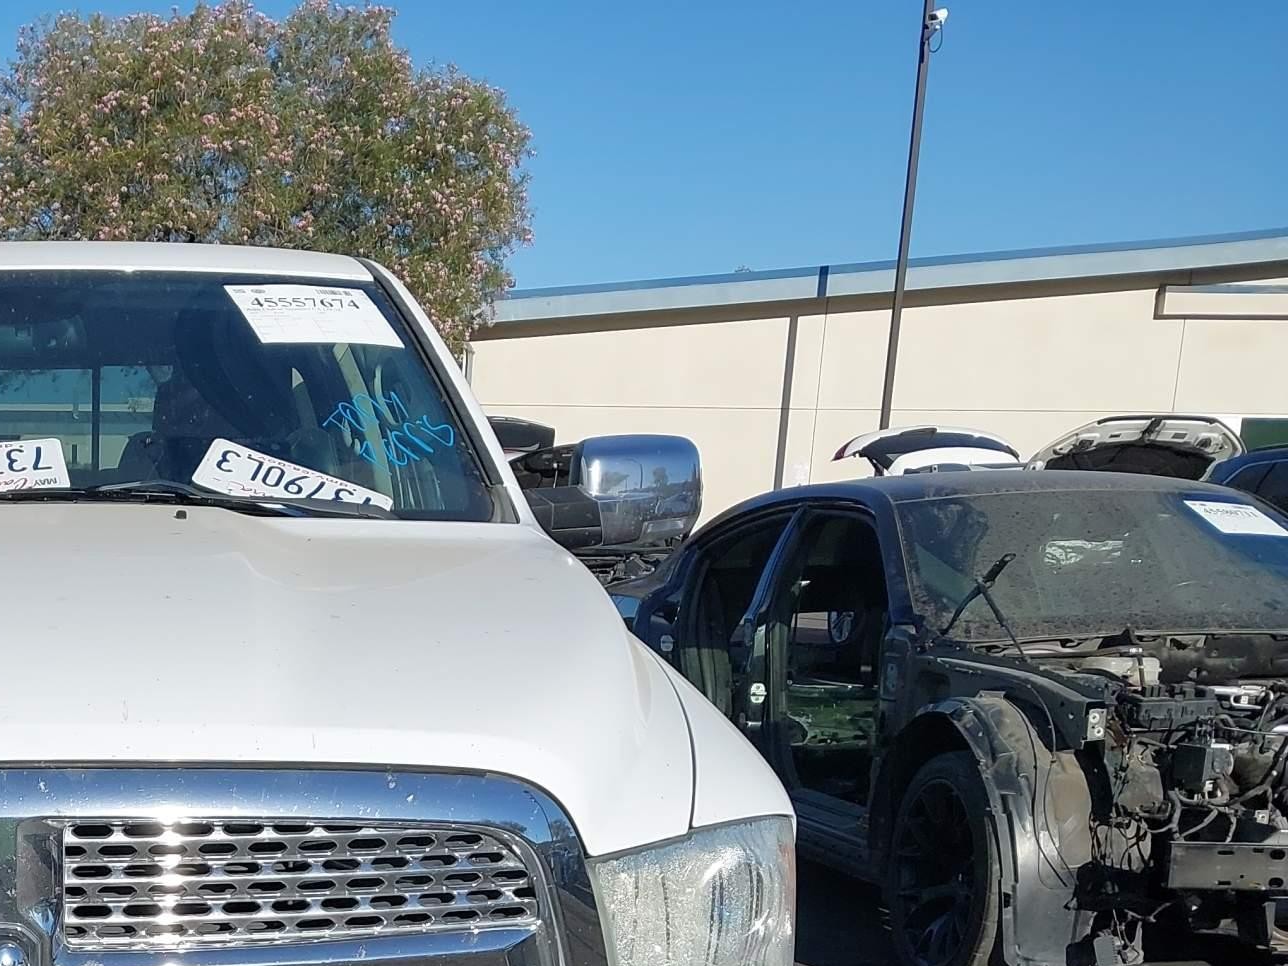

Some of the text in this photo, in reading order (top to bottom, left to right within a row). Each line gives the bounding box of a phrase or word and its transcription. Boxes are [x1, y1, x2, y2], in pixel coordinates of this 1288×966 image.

[251, 297, 360, 309] 45557674
[34, 477, 58, 487] MAY
[215, 450, 373, 505] 3790L3
